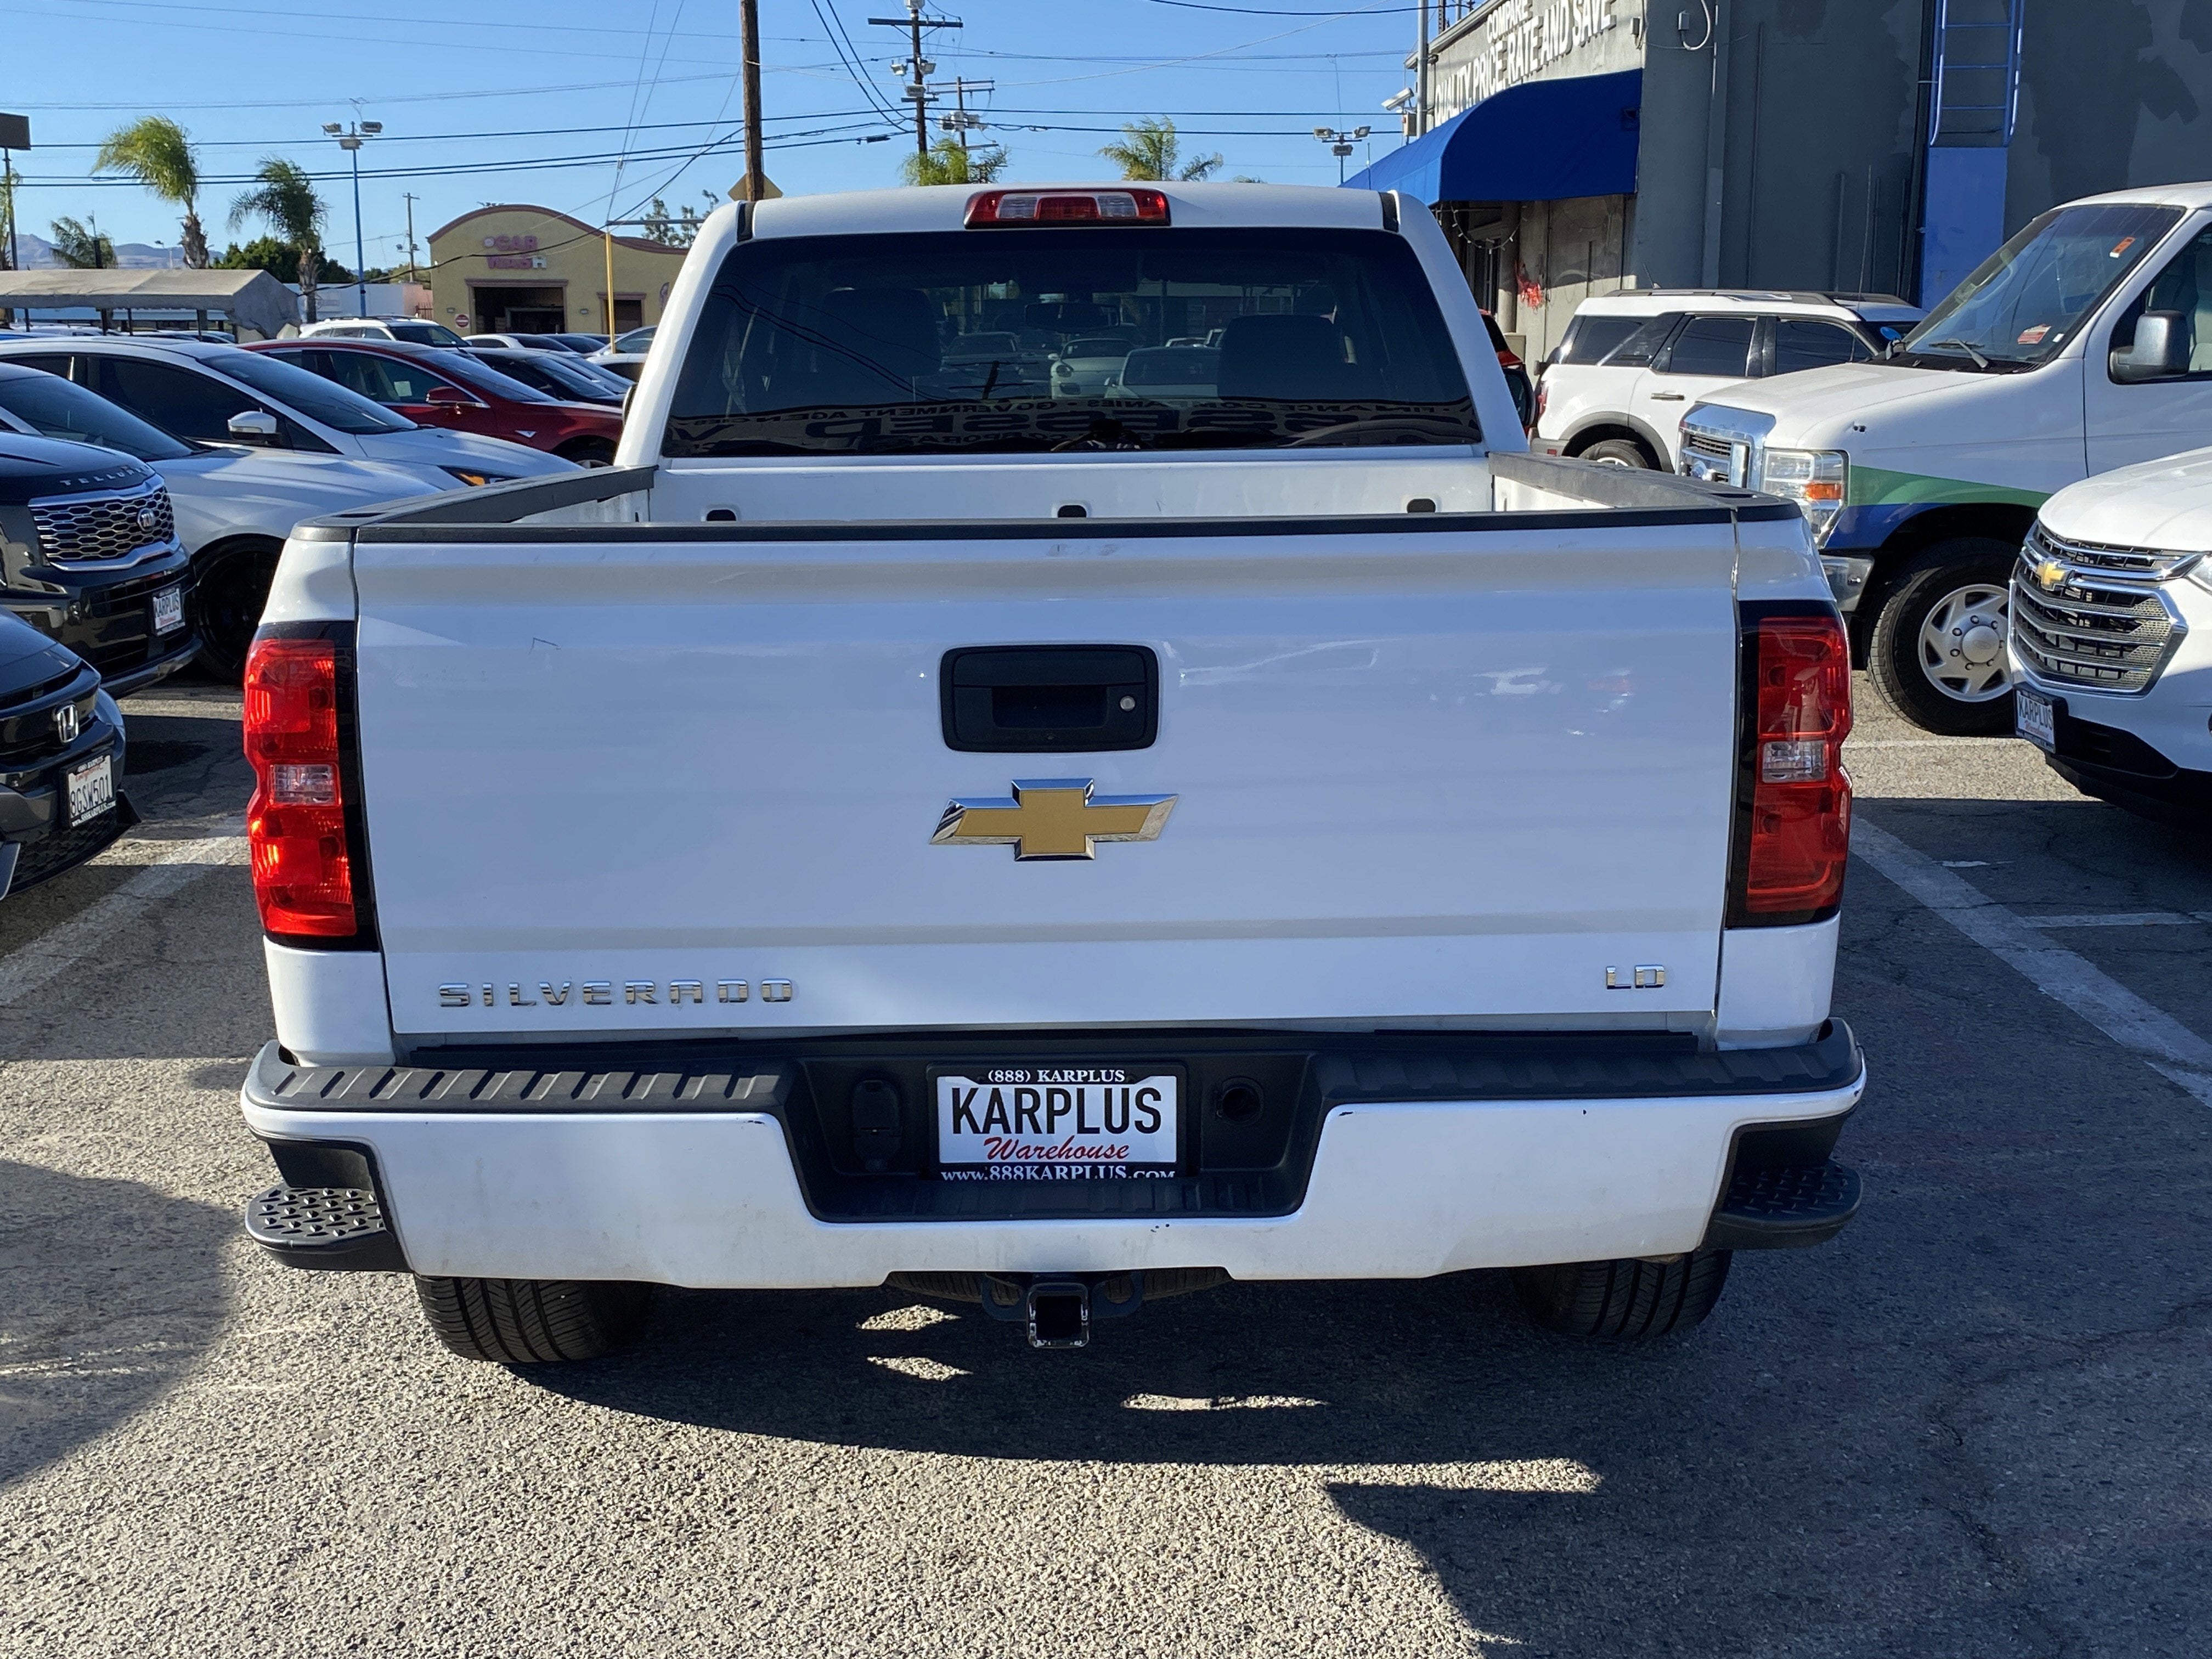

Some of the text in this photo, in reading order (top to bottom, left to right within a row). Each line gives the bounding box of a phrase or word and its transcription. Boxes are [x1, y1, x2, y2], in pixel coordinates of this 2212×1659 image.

[1487, 0, 1528, 43] COMPARE
[1508, 15, 1539, 85] RATE
[1540, 0, 1570, 66] AND
[495, 235, 538, 251] CAR
[2018, 695, 2053, 731] KARPLUS
[1606, 964, 1664, 989] LD
[438, 979, 791, 1007] SILVERADO
[988, 1069, 1125, 1083] (888) KARPLUS
[951, 1087, 1162, 1135] KARPLUS
[983, 1135, 1130, 1160] Warehouse
